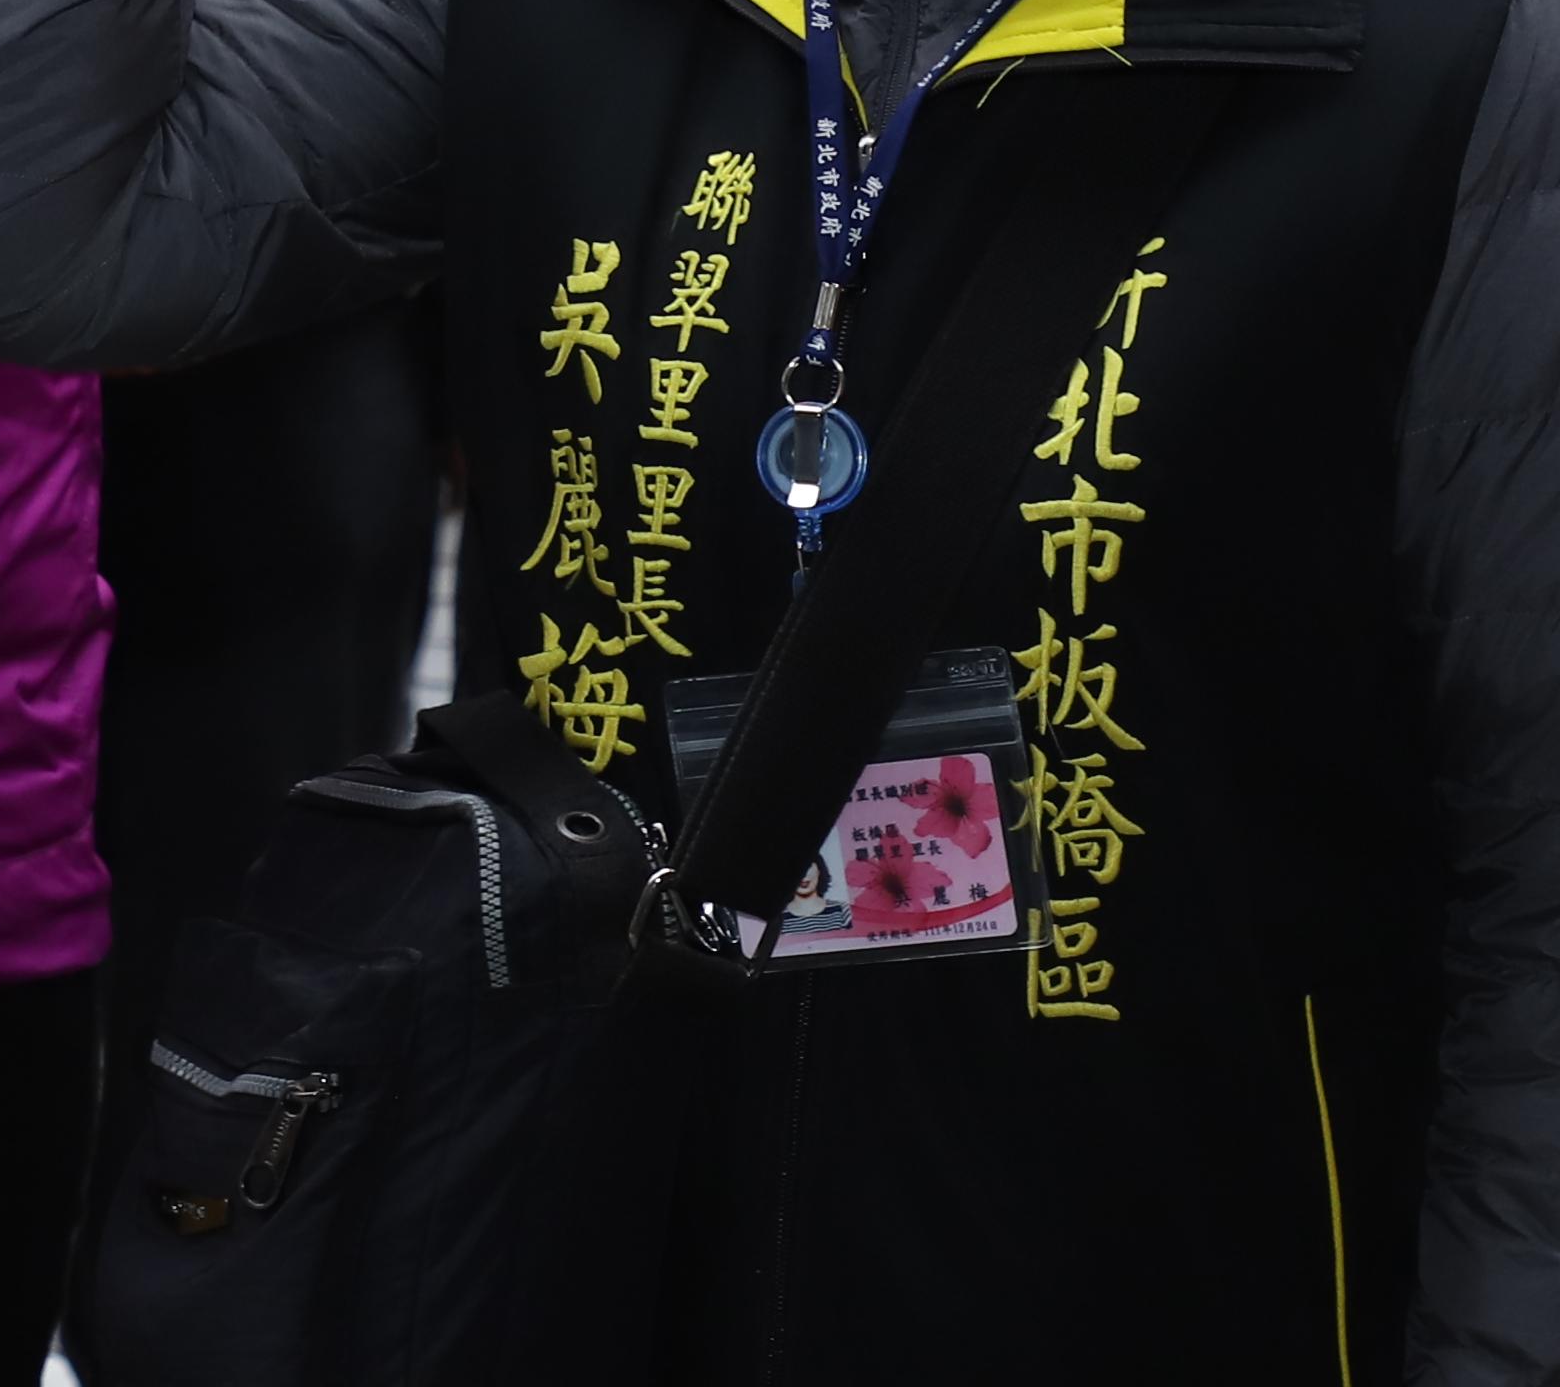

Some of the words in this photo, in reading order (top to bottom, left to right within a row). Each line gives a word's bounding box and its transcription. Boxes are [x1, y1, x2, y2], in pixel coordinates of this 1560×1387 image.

[616, 150, 757, 658] 聯翠里里長
[816, 116, 843, 238] 新北市政府
[519, 237, 647, 774] 吳麗梅
